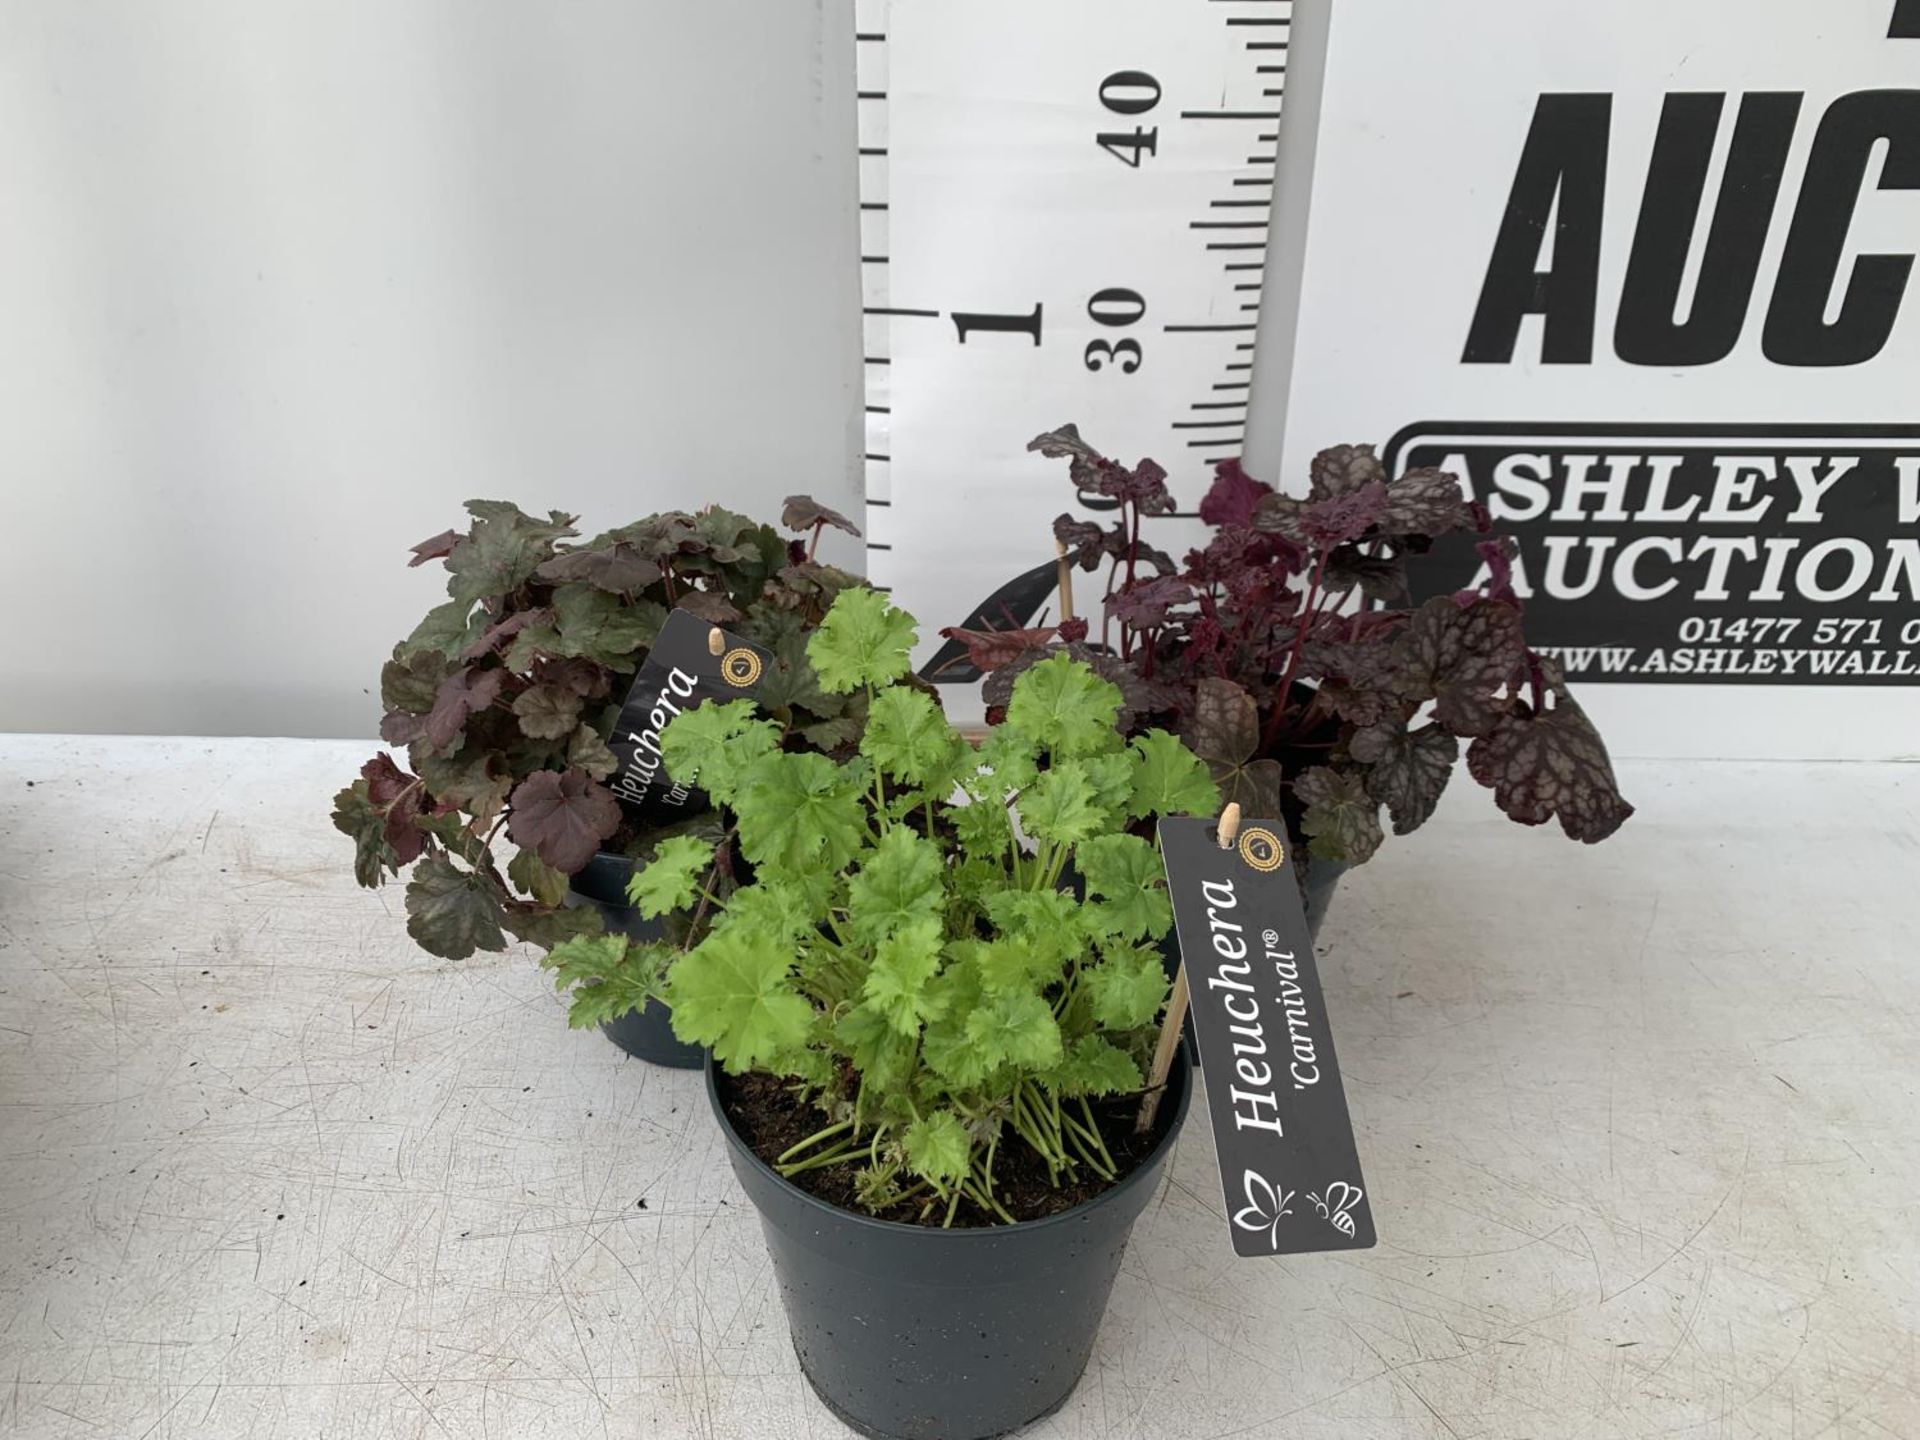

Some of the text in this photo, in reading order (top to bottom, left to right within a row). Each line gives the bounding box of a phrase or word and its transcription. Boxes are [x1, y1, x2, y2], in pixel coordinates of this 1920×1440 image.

[1096, 70, 1162, 167] 40
[1084, 287, 1146, 374] 30
[1527, 646, 1920, 675] WW.ASHLEYWALL
[1678, 617, 1801, 643] 01477
[1812, 618, 1882, 644] 571
[610, 666, 698, 805] Heuchera
[1201, 879, 1284, 1138] Heuchera
